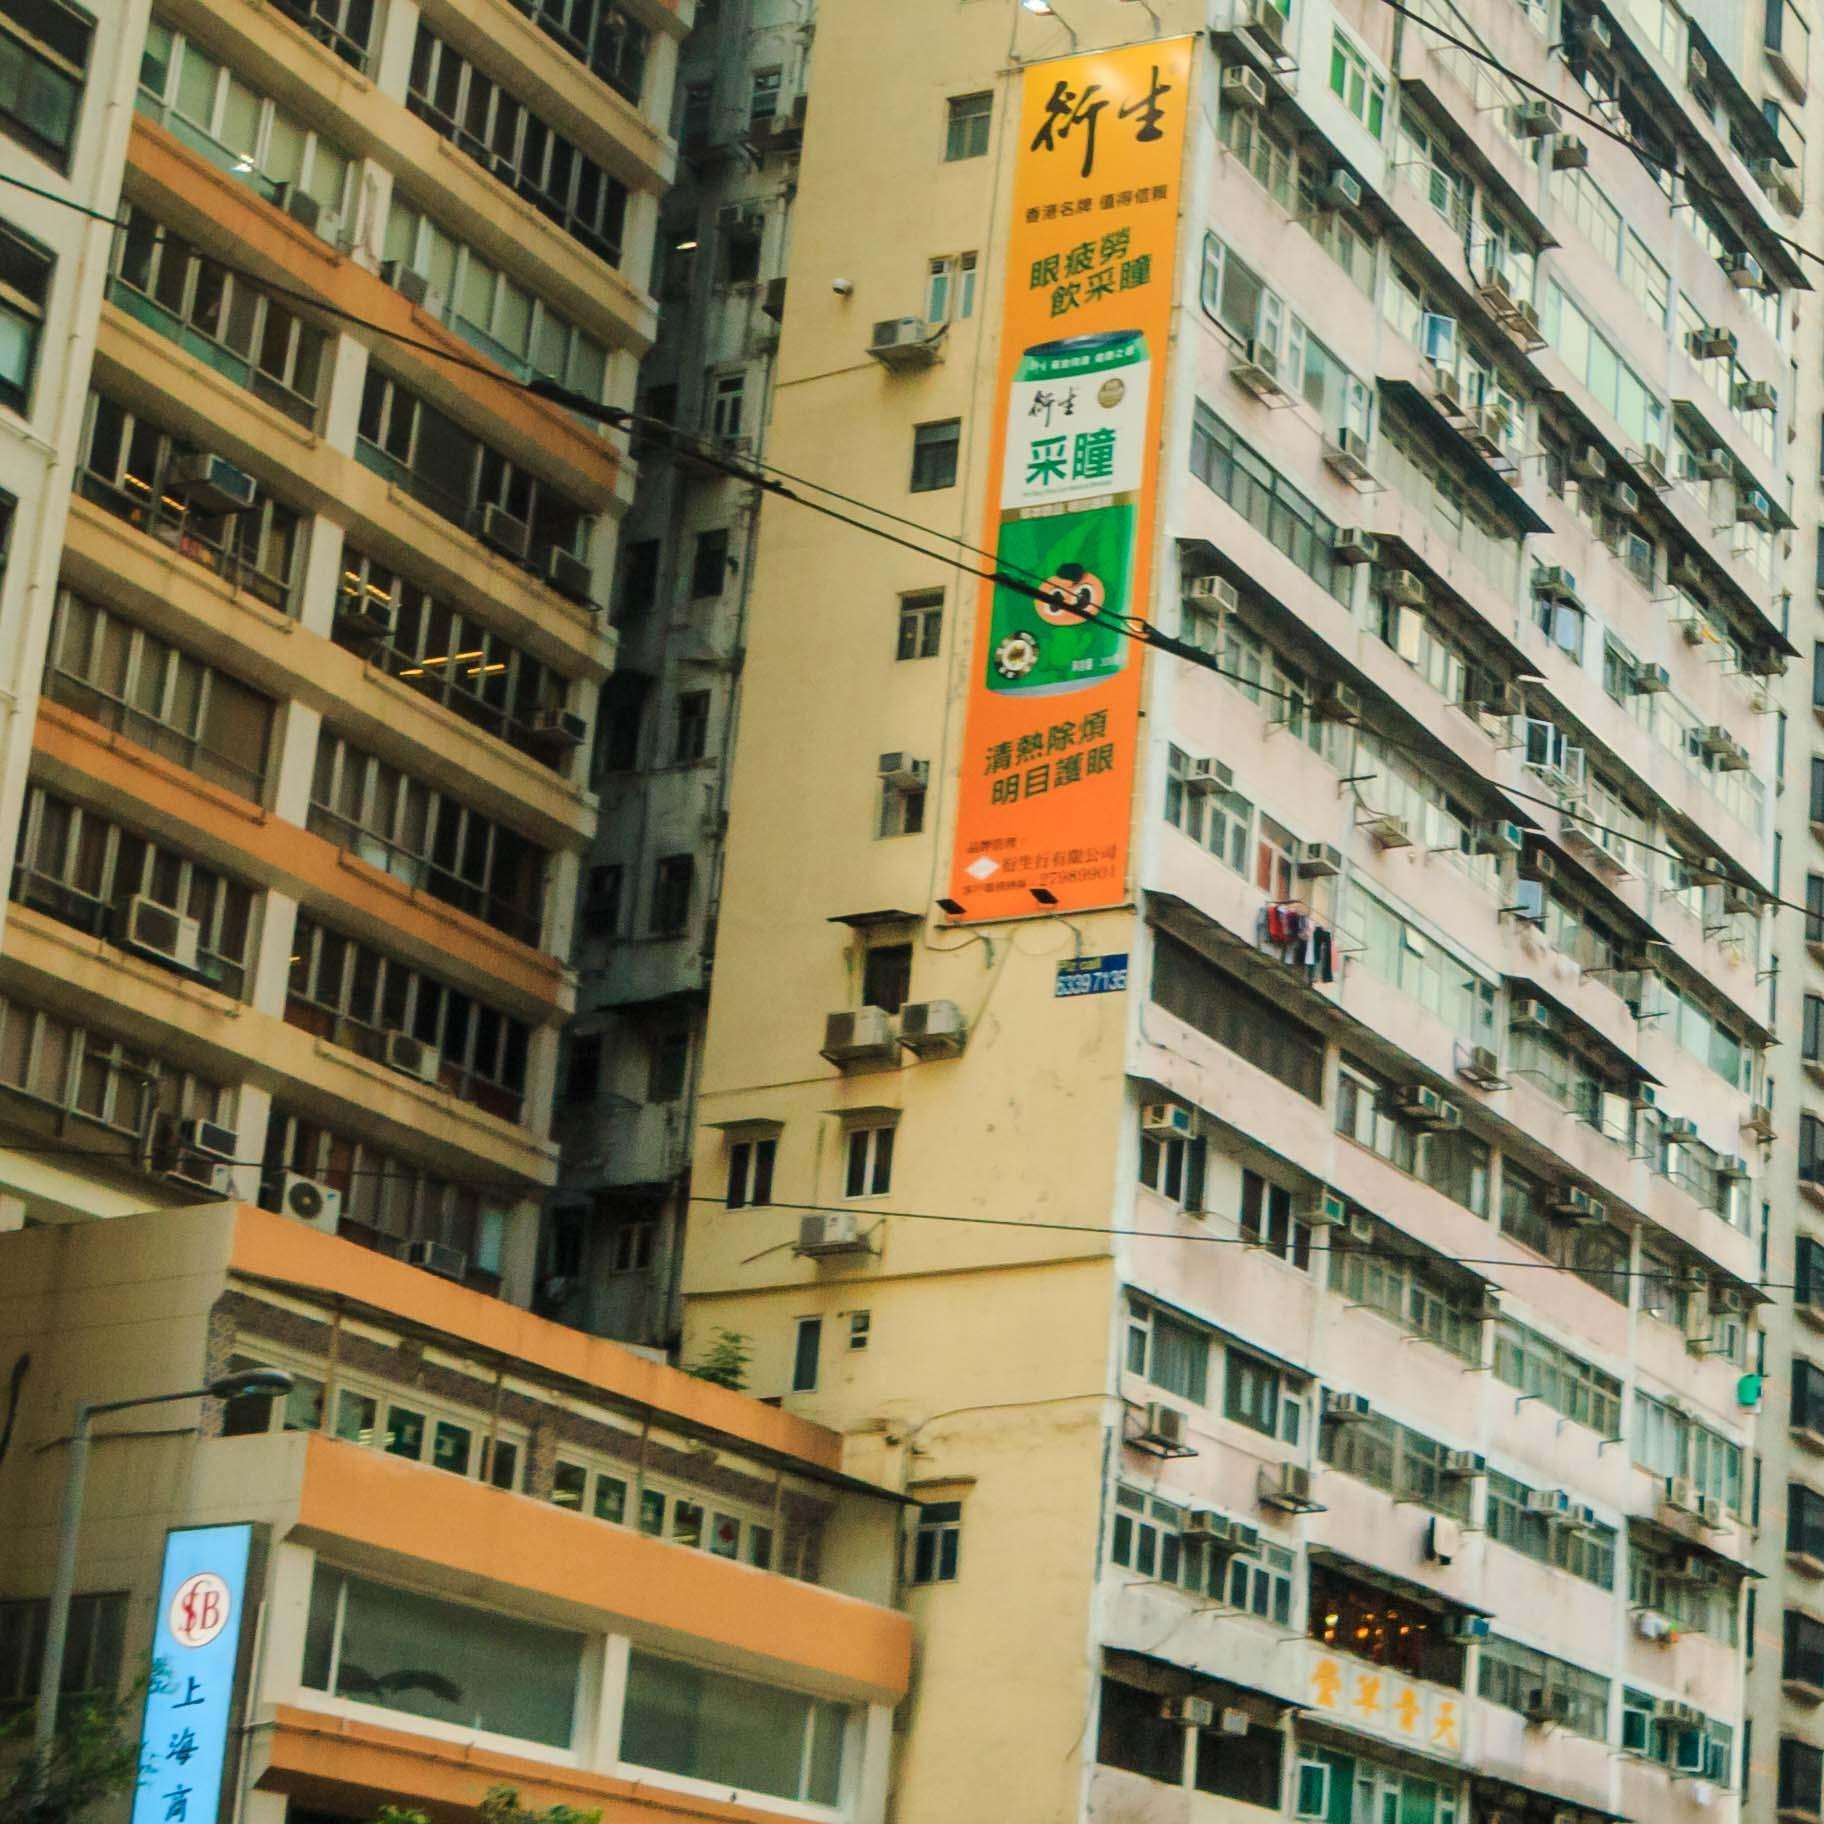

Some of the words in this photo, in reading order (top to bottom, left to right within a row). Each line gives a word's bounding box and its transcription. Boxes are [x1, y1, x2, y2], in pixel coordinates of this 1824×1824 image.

[1030, 65, 1172, 178] 衍生
[1029, 226, 1131, 290] 眼疲勞
[1050, 253, 1153, 318] 飲采瞳
[1025, 427, 1116, 486] 采瞳
[983, 708, 1109, 777] 清熱除煩
[991, 742, 1115, 807] 明目護眼
